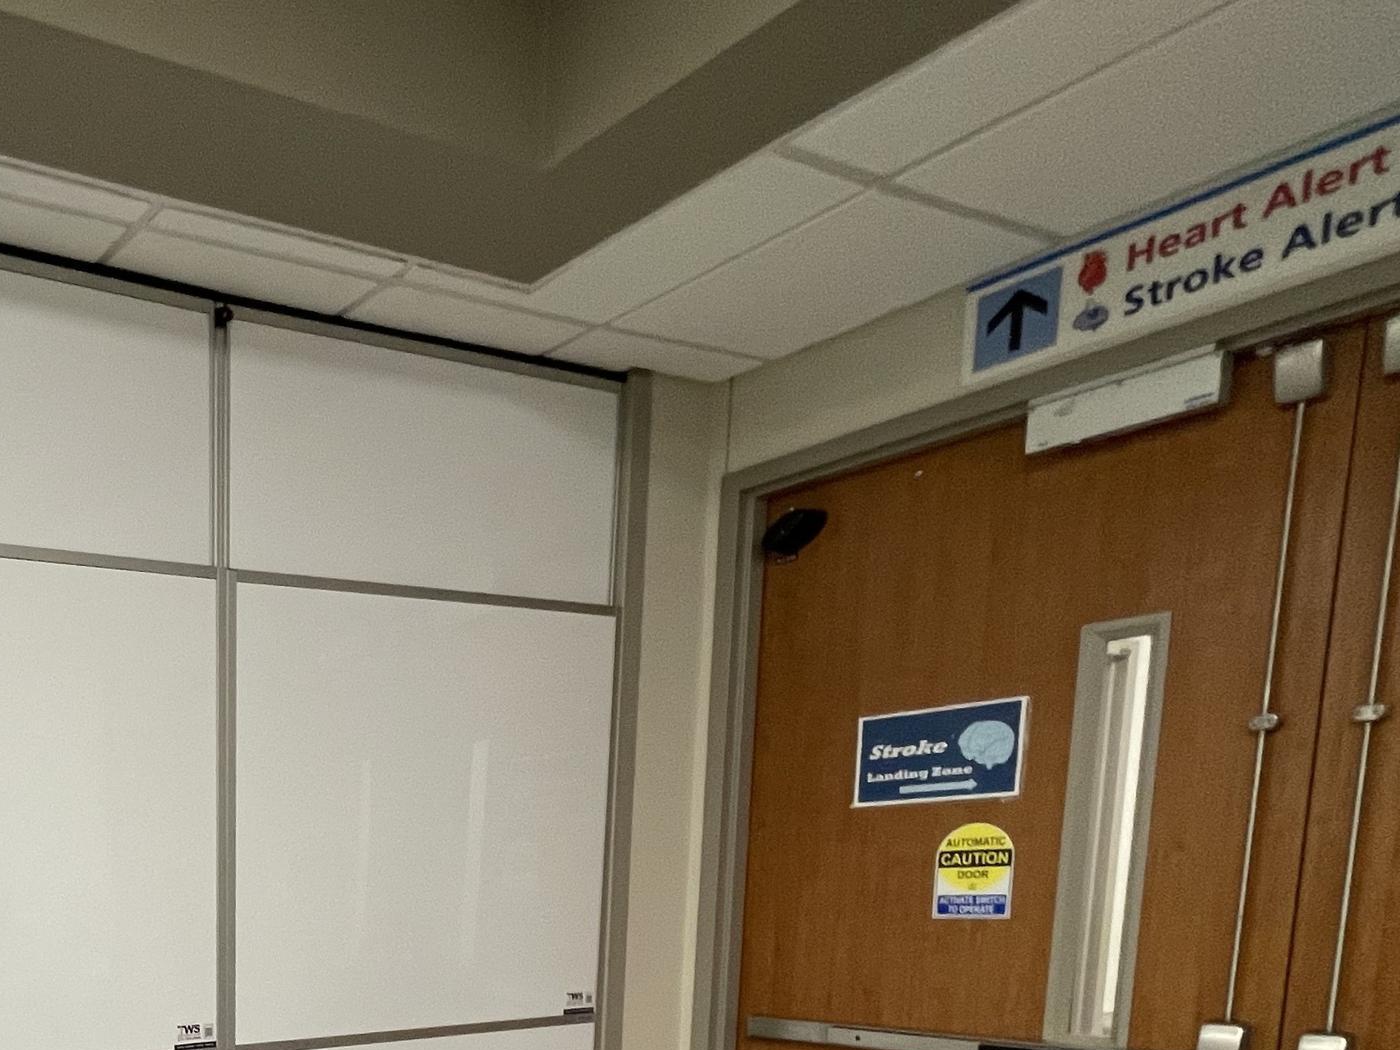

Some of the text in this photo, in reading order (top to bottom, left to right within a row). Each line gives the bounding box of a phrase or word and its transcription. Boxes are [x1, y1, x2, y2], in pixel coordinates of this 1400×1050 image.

[1126, 145, 1392, 272] Heart Alert
[1123, 245, 1265, 318] Stroke
[869, 739, 948, 760] Stroke
[866, 764, 973, 783] Landing Zone
[945, 836, 1006, 848] AUTOMATIC
[940, 851, 1009, 866] CAUTION
[957, 870, 989, 879] DOOR
